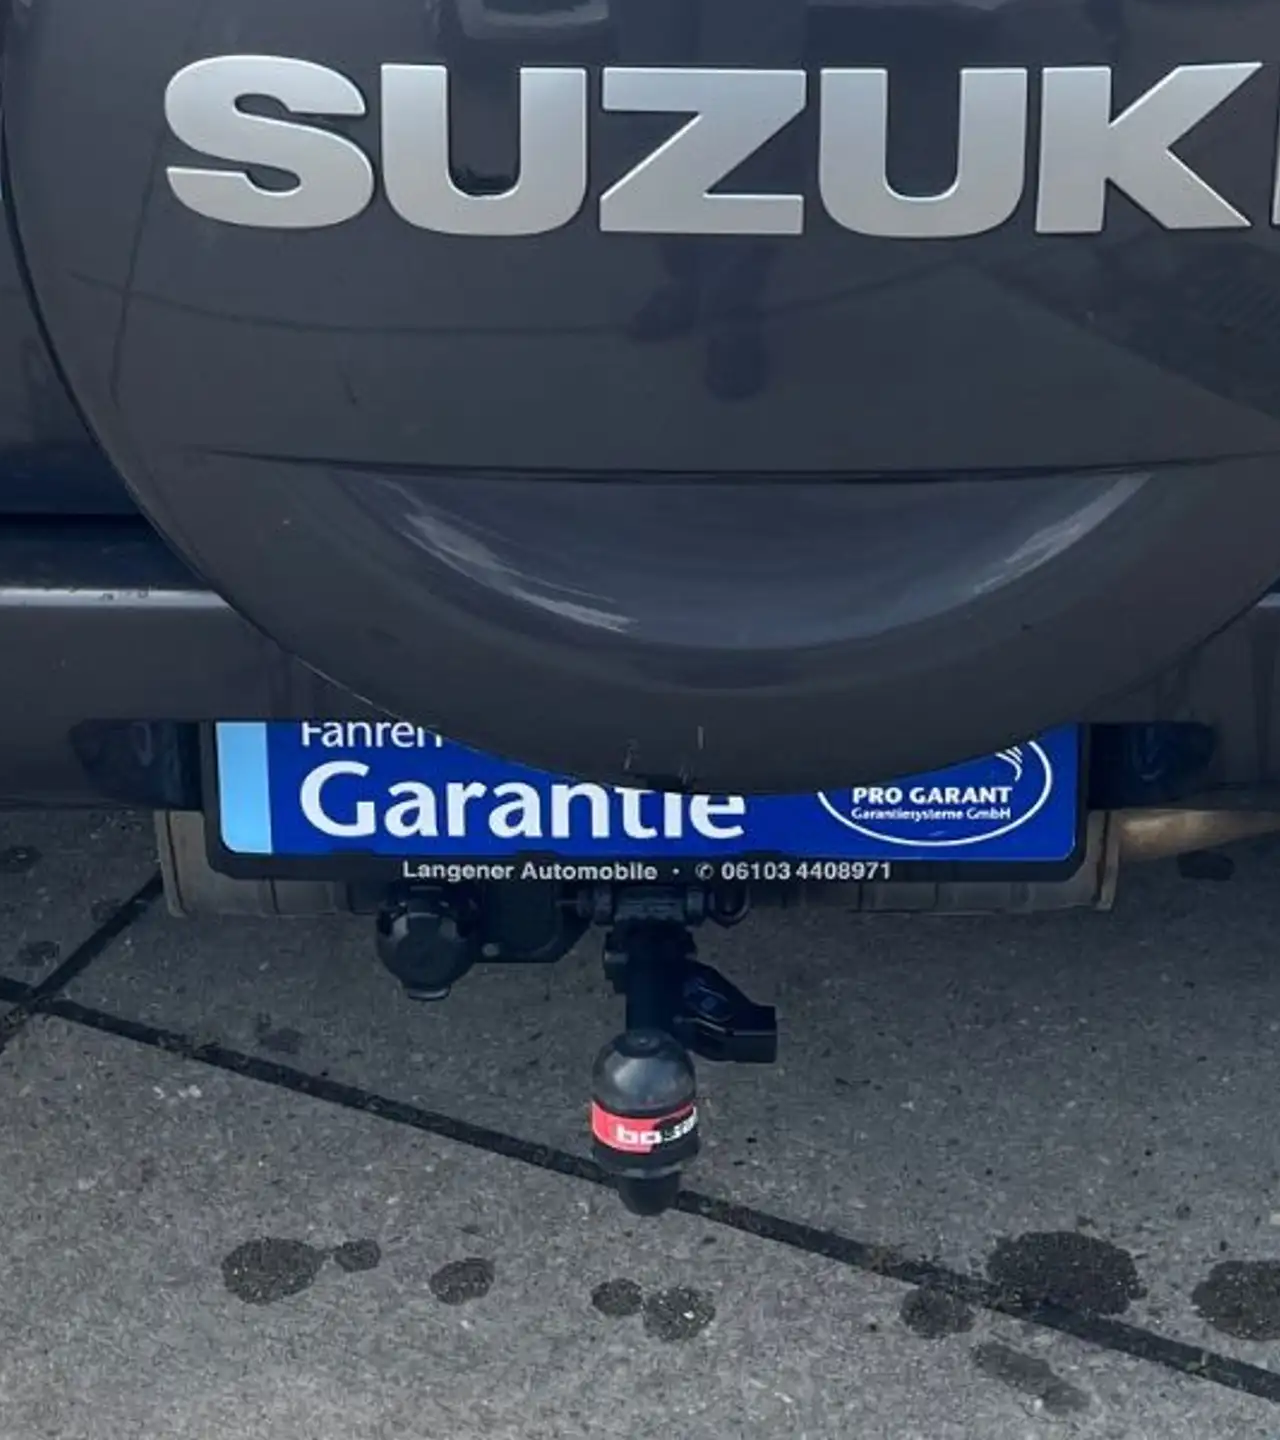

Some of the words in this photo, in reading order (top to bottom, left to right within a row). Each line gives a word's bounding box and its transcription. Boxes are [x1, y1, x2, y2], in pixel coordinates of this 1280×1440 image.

[299, 759, 747, 840] Garantie
[851, 786, 904, 805] PRO
[909, 786, 1014, 805] GARANT
[966, 806, 1012, 821] GmbH
[403, 860, 516, 882] Langener
[520, 861, 659, 880] Automobile
[721, 861, 791, 881] 06103
[795, 861, 892, 881] 4408971
